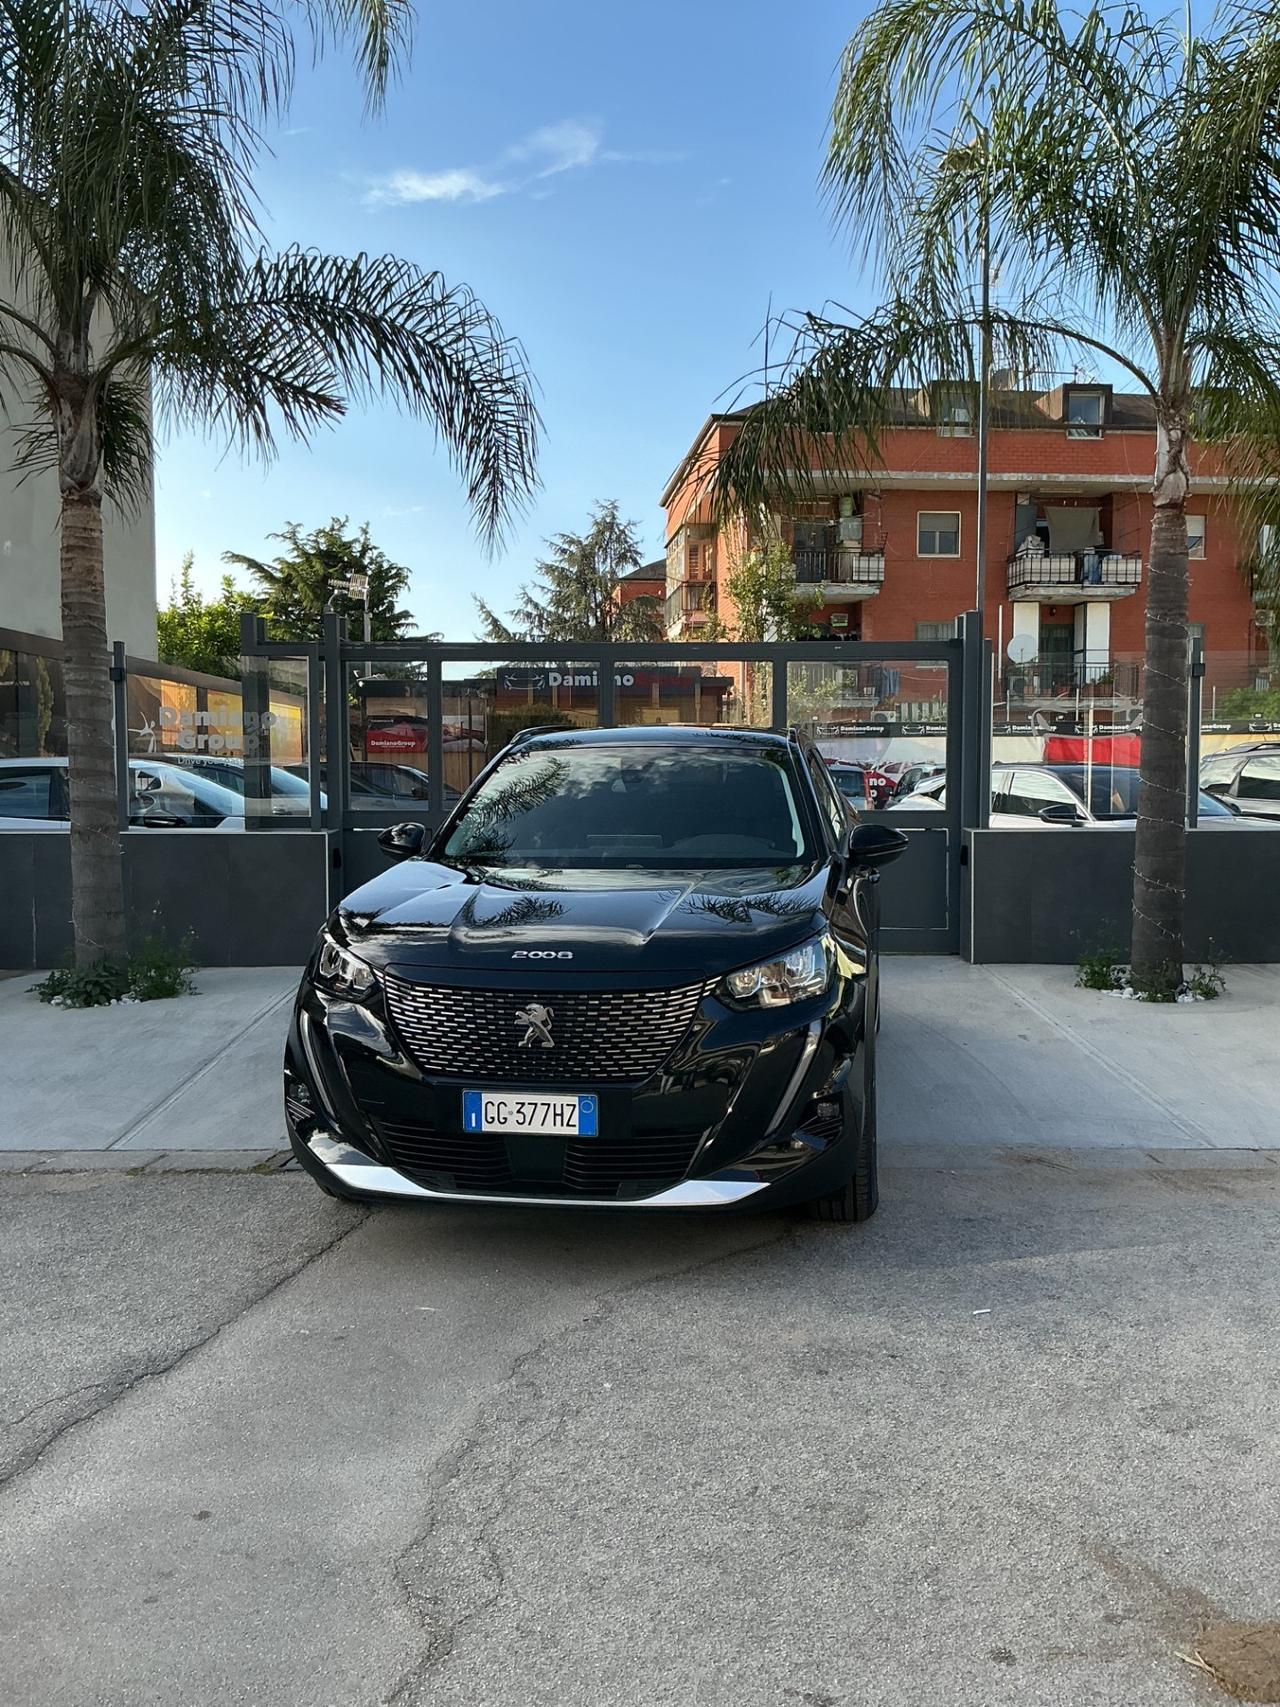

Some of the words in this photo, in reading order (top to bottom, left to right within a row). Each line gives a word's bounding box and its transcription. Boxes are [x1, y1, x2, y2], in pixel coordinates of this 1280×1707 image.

[548, 671, 634, 687] Damino
[159, 705, 276, 726] Damiano
[179, 731, 259, 755] Group
[868, 777, 887, 787] no
[511, 950, 573, 959] 2008
[484, 1100, 508, 1125] GG
[515, 1101, 577, 1128] 377HZ
